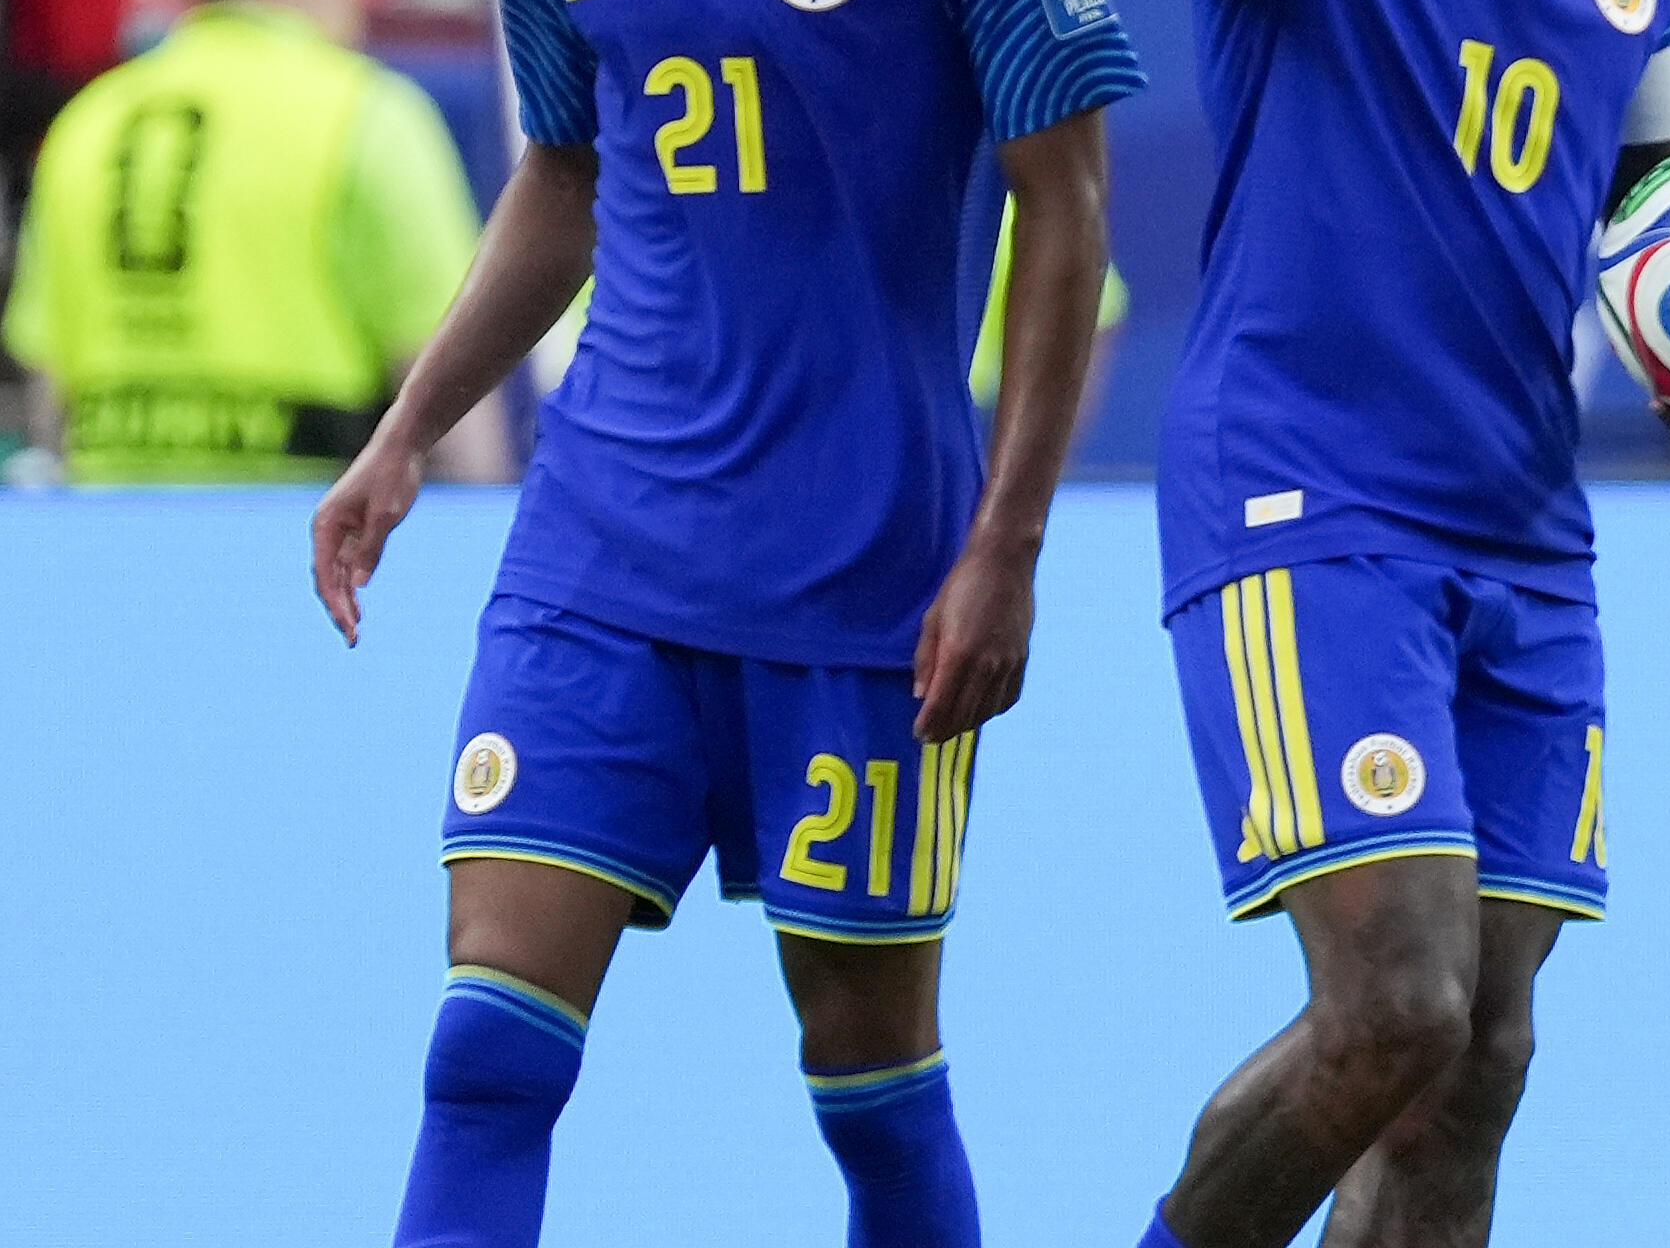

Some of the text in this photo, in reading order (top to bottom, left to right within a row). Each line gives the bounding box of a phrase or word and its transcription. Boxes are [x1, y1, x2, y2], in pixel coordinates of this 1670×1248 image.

[643, 55, 768, 195] 21
[1453, 38, 1560, 194] 10
[779, 752, 899, 897] 21
[1569, 724, 1607, 869] 1
